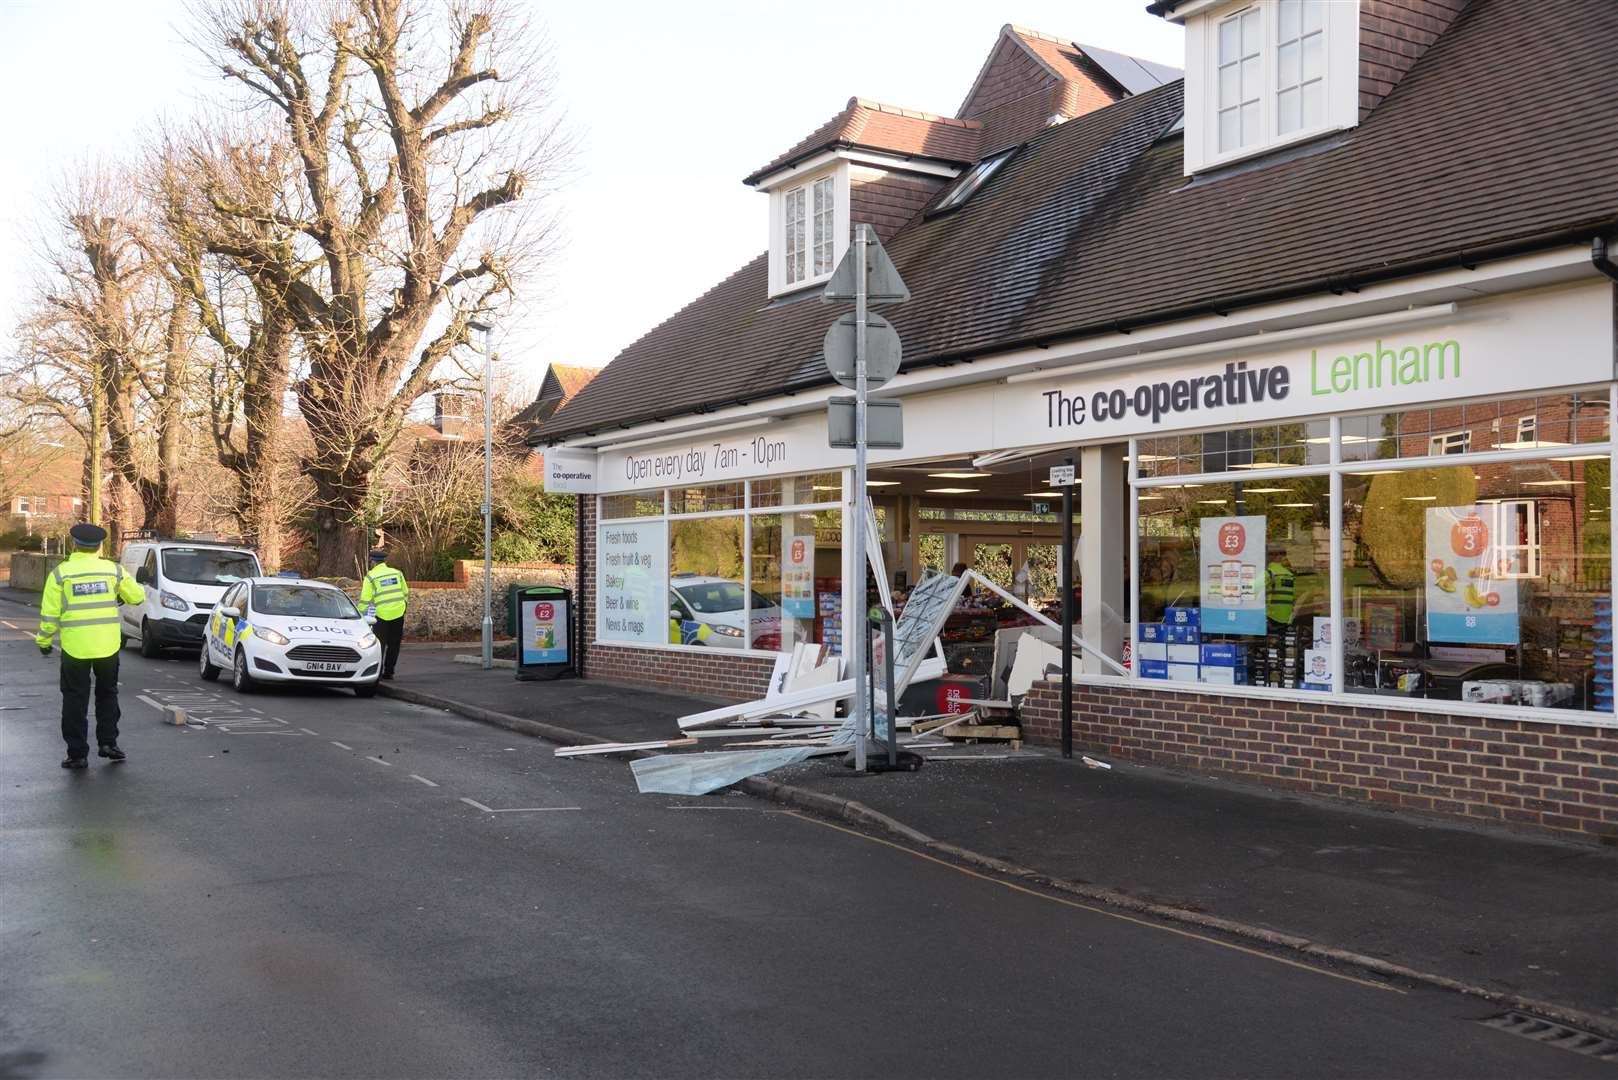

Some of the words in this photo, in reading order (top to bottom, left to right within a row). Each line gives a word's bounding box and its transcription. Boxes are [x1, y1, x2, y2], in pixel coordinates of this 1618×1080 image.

[1043, 391, 1086, 428] The
[1091, 361, 1290, 423] co-operative
[1311, 339, 1461, 396] Lenham
[626, 455, 652, 484] Open
[655, 452, 684, 479] every
[687, 448, 706, 476] day
[713, 443, 738, 469] 7am
[752, 436, 786, 467] 10pm
[552, 472, 592, 480] co-operative
[606, 532, 620, 545] Fresh
[622, 530, 638, 544] foods
[1225, 535, 1239, 548] £3
[1464, 535, 1475, 551] 3
[605, 552, 620, 567] Fresh
[622, 552, 634, 566] fruit
[635, 552, 640, 565] &
[641, 554, 652, 568] veg
[75, 582, 106, 591] POLICE
[605, 595, 618, 610] Beer
[620, 596, 625, 609] &
[540, 610, 550, 618] £2
[288, 625, 353, 636] POLICE
[605, 618, 620, 632] News
[622, 619, 628, 632] &
[629, 618, 644, 635] mags
[211, 634, 233, 660] POLICE
[306, 662, 326, 671] GN14
[327, 662, 343, 671] BAV
